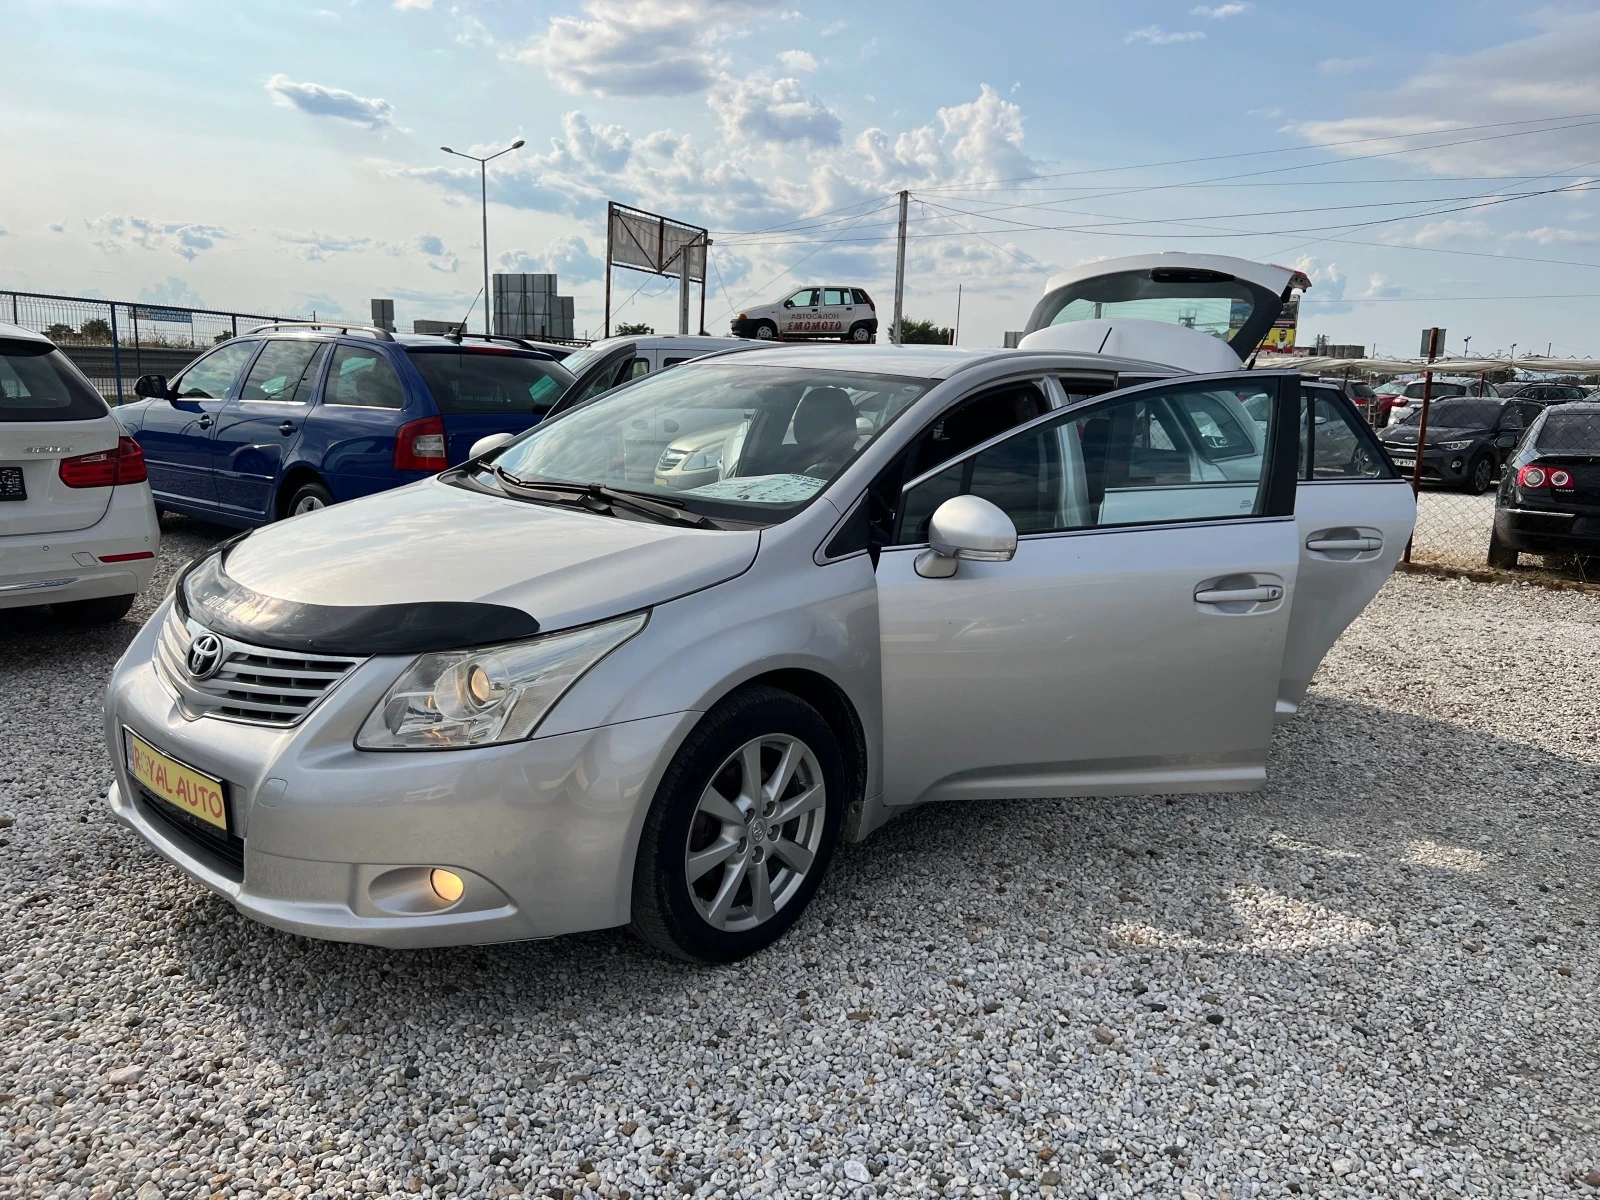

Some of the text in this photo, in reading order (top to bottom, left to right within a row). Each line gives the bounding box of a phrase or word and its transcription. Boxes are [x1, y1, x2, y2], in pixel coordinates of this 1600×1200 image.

[790, 312, 840, 320] АВТОСАЛОН
[133, 744, 223, 819] ROYAL AUTO
